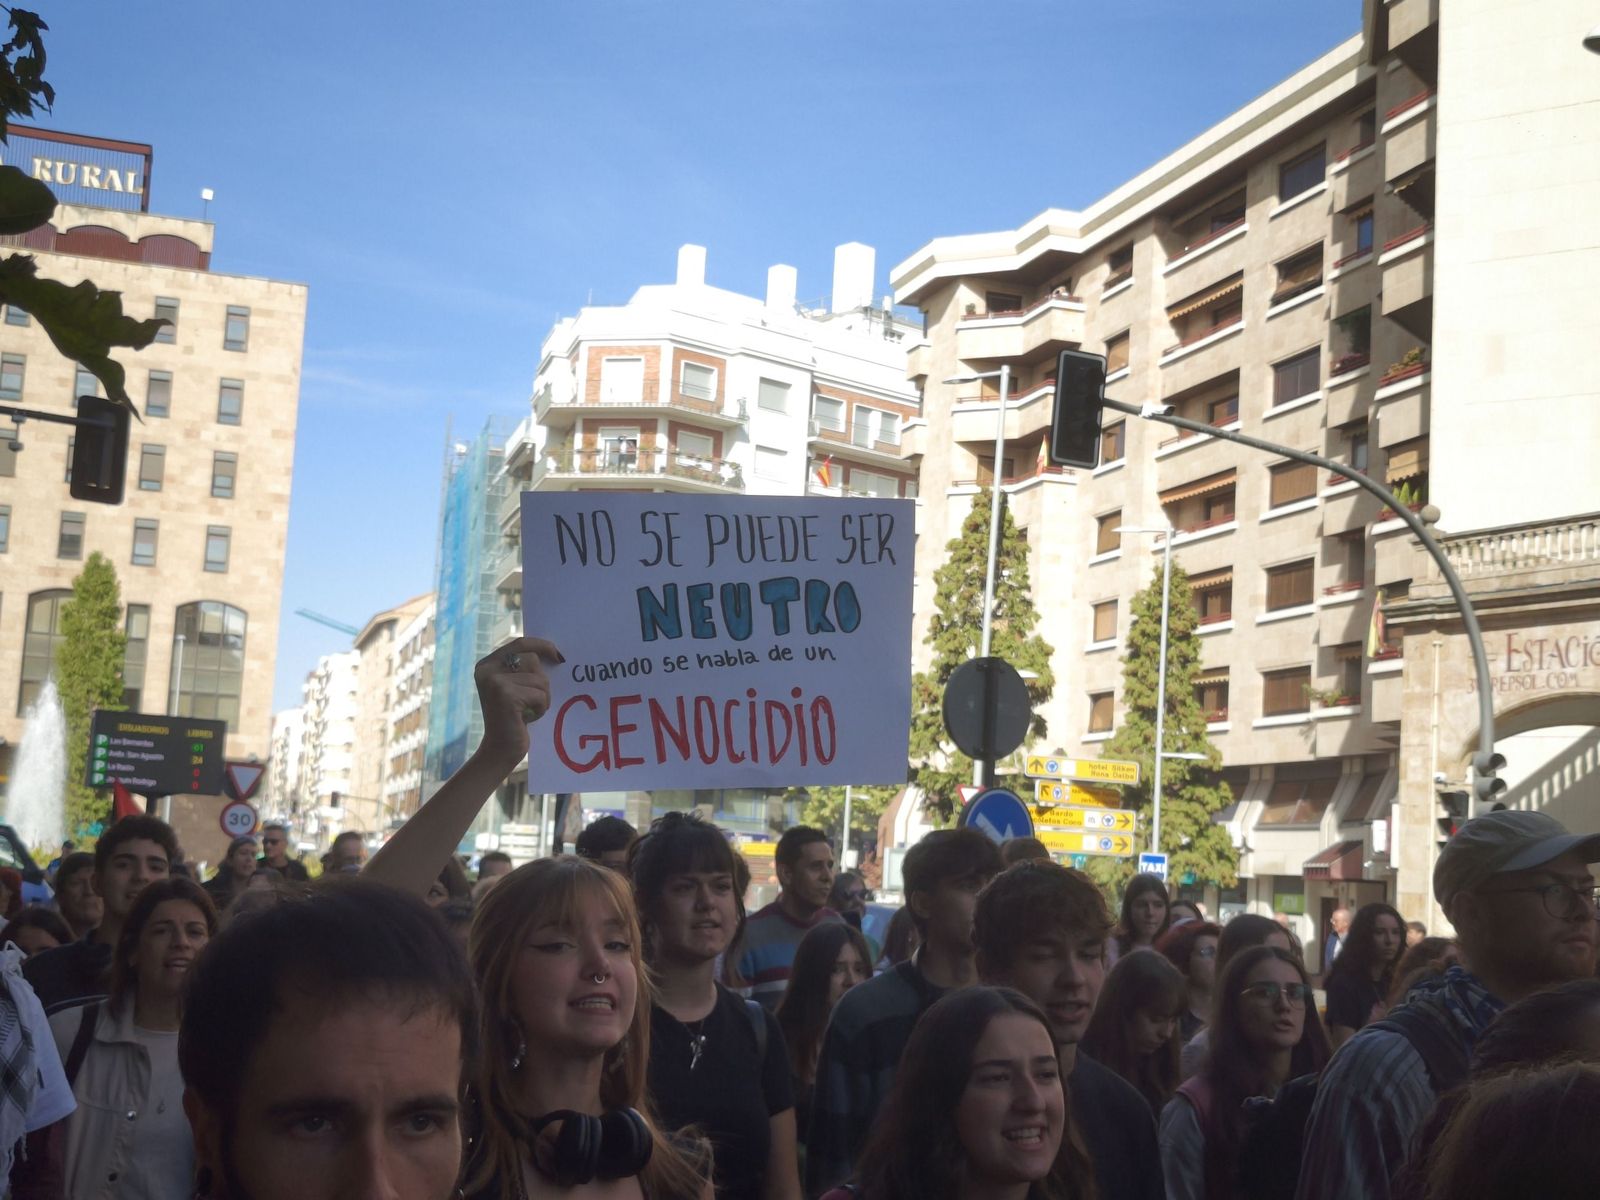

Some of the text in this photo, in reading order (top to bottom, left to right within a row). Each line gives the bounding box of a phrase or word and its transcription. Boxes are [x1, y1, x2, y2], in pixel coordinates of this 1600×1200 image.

[32, 157, 143, 194] RURAL
[553, 509, 897, 568] NO SE PUEDE SER
[635, 576, 862, 642] NEUTRO
[572, 656, 653, 683] cuando
[663, 655, 688, 673] se
[767, 644, 794, 662] de
[805, 646, 837, 662] un
[229, 813, 251, 826] 30
[1141, 863, 1166, 873] TAXI
